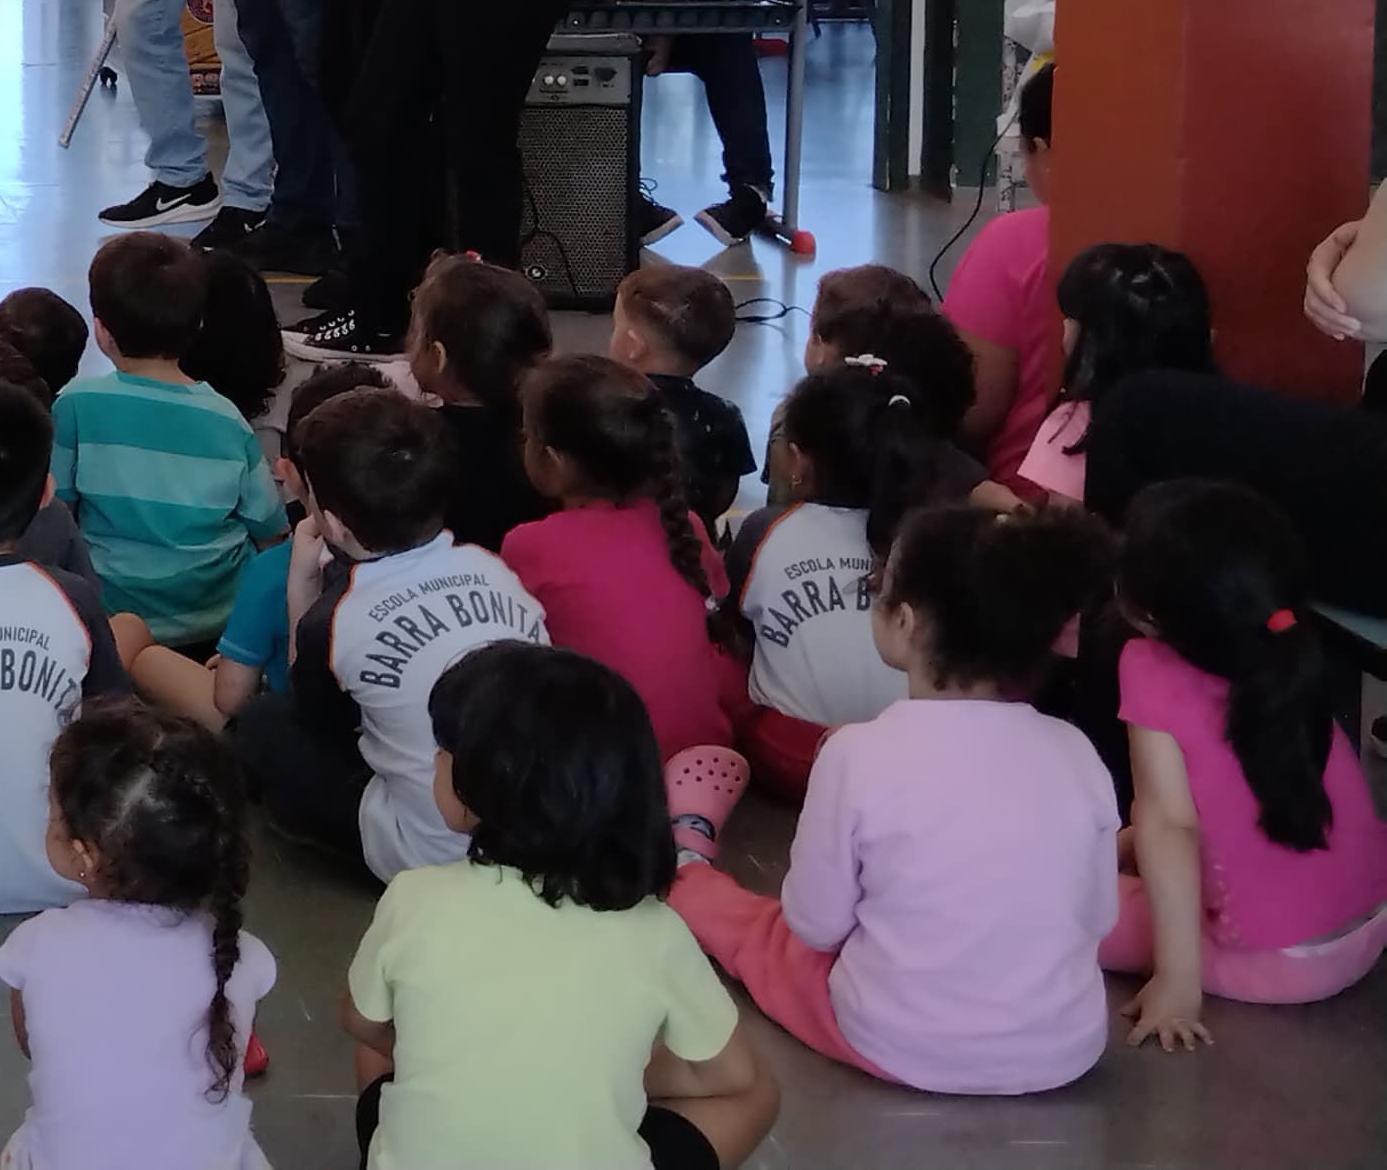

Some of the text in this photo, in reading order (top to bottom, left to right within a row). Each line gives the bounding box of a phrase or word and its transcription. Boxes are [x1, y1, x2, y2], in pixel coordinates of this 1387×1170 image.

[368, 573, 490, 623] ESCOLA MUNICIPAL
[784, 557, 835, 580] ESCOLA
[761, 575, 846, 648] BARRA
[360, 603, 449, 690] BARRA
